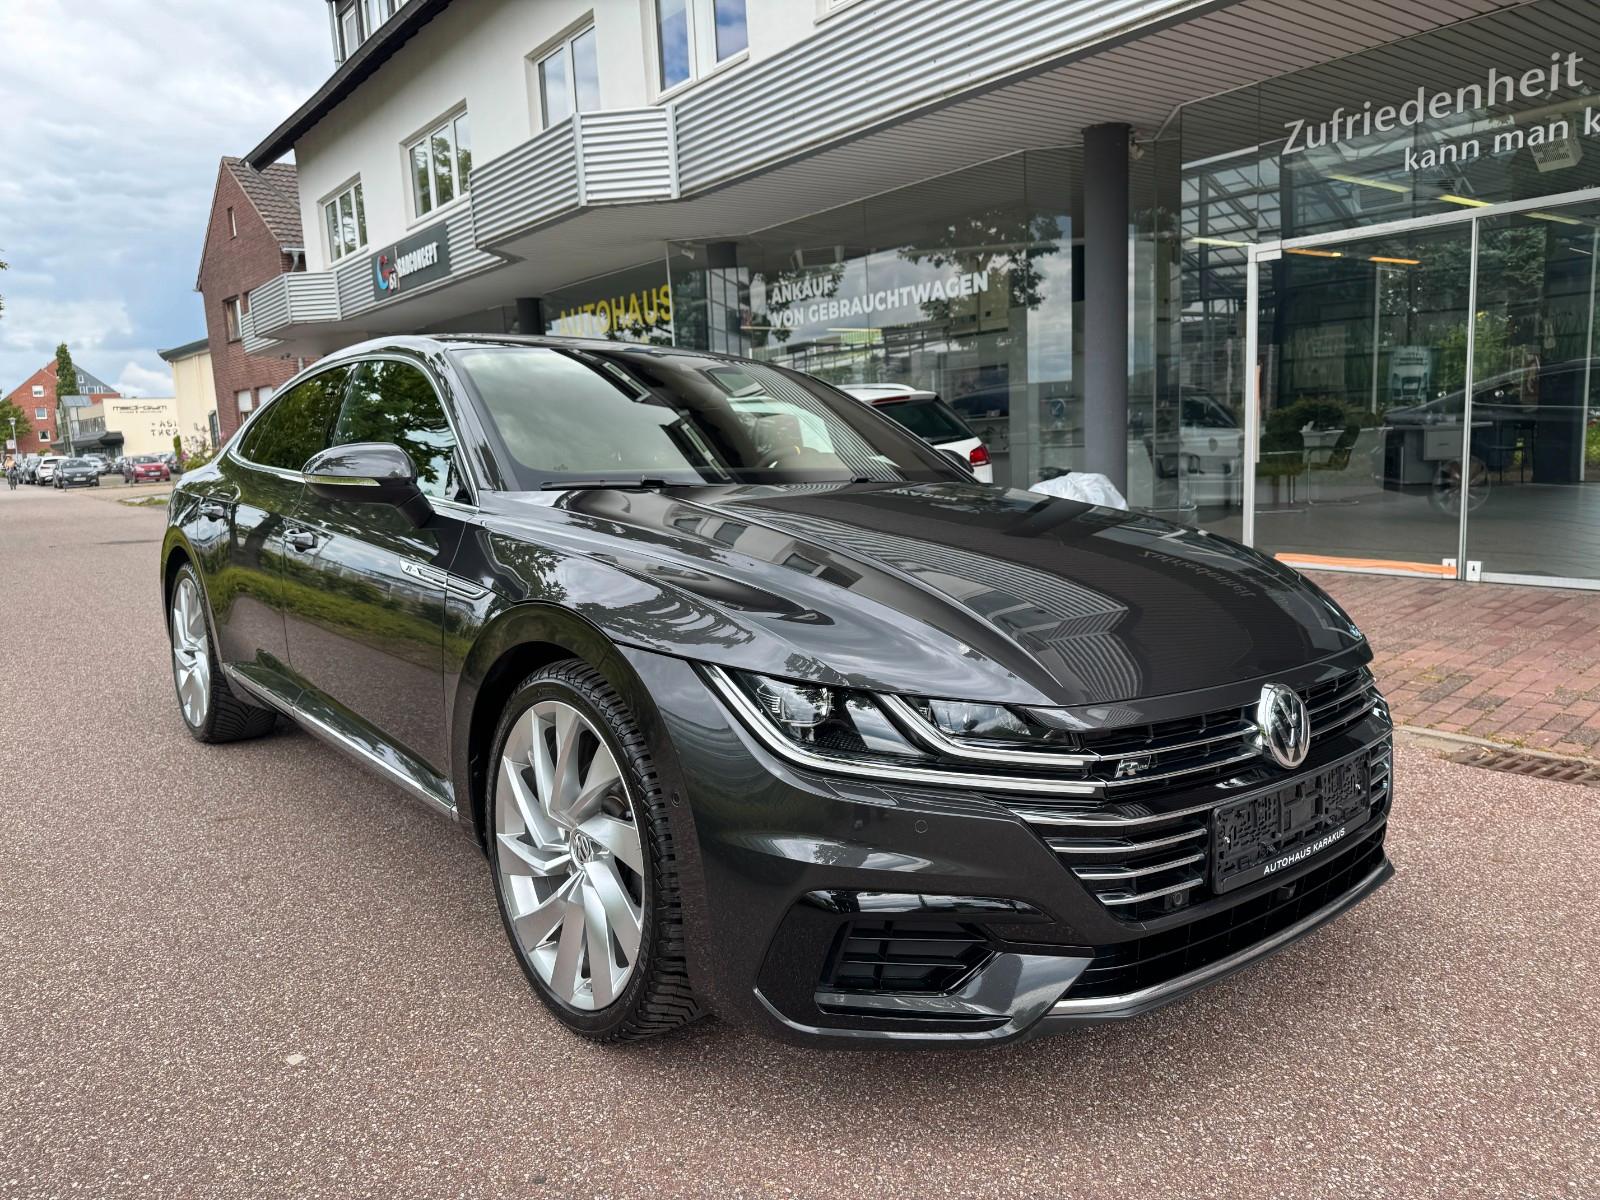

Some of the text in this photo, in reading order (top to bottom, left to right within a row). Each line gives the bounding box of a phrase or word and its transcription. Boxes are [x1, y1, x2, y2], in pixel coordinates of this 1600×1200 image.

[1282, 51, 1584, 155] Zufriedenheit
[1404, 138, 1479, 171] kann
[1494, 119, 1568, 153] man
[560, 284, 671, 337] AUTOHAUS
[771, 275, 833, 304] ANKAUF
[772, 270, 988, 328] VON GEBRAUCHTWAGEN
[1263, 827, 1346, 875] AUTOHAUS KARAKUS
